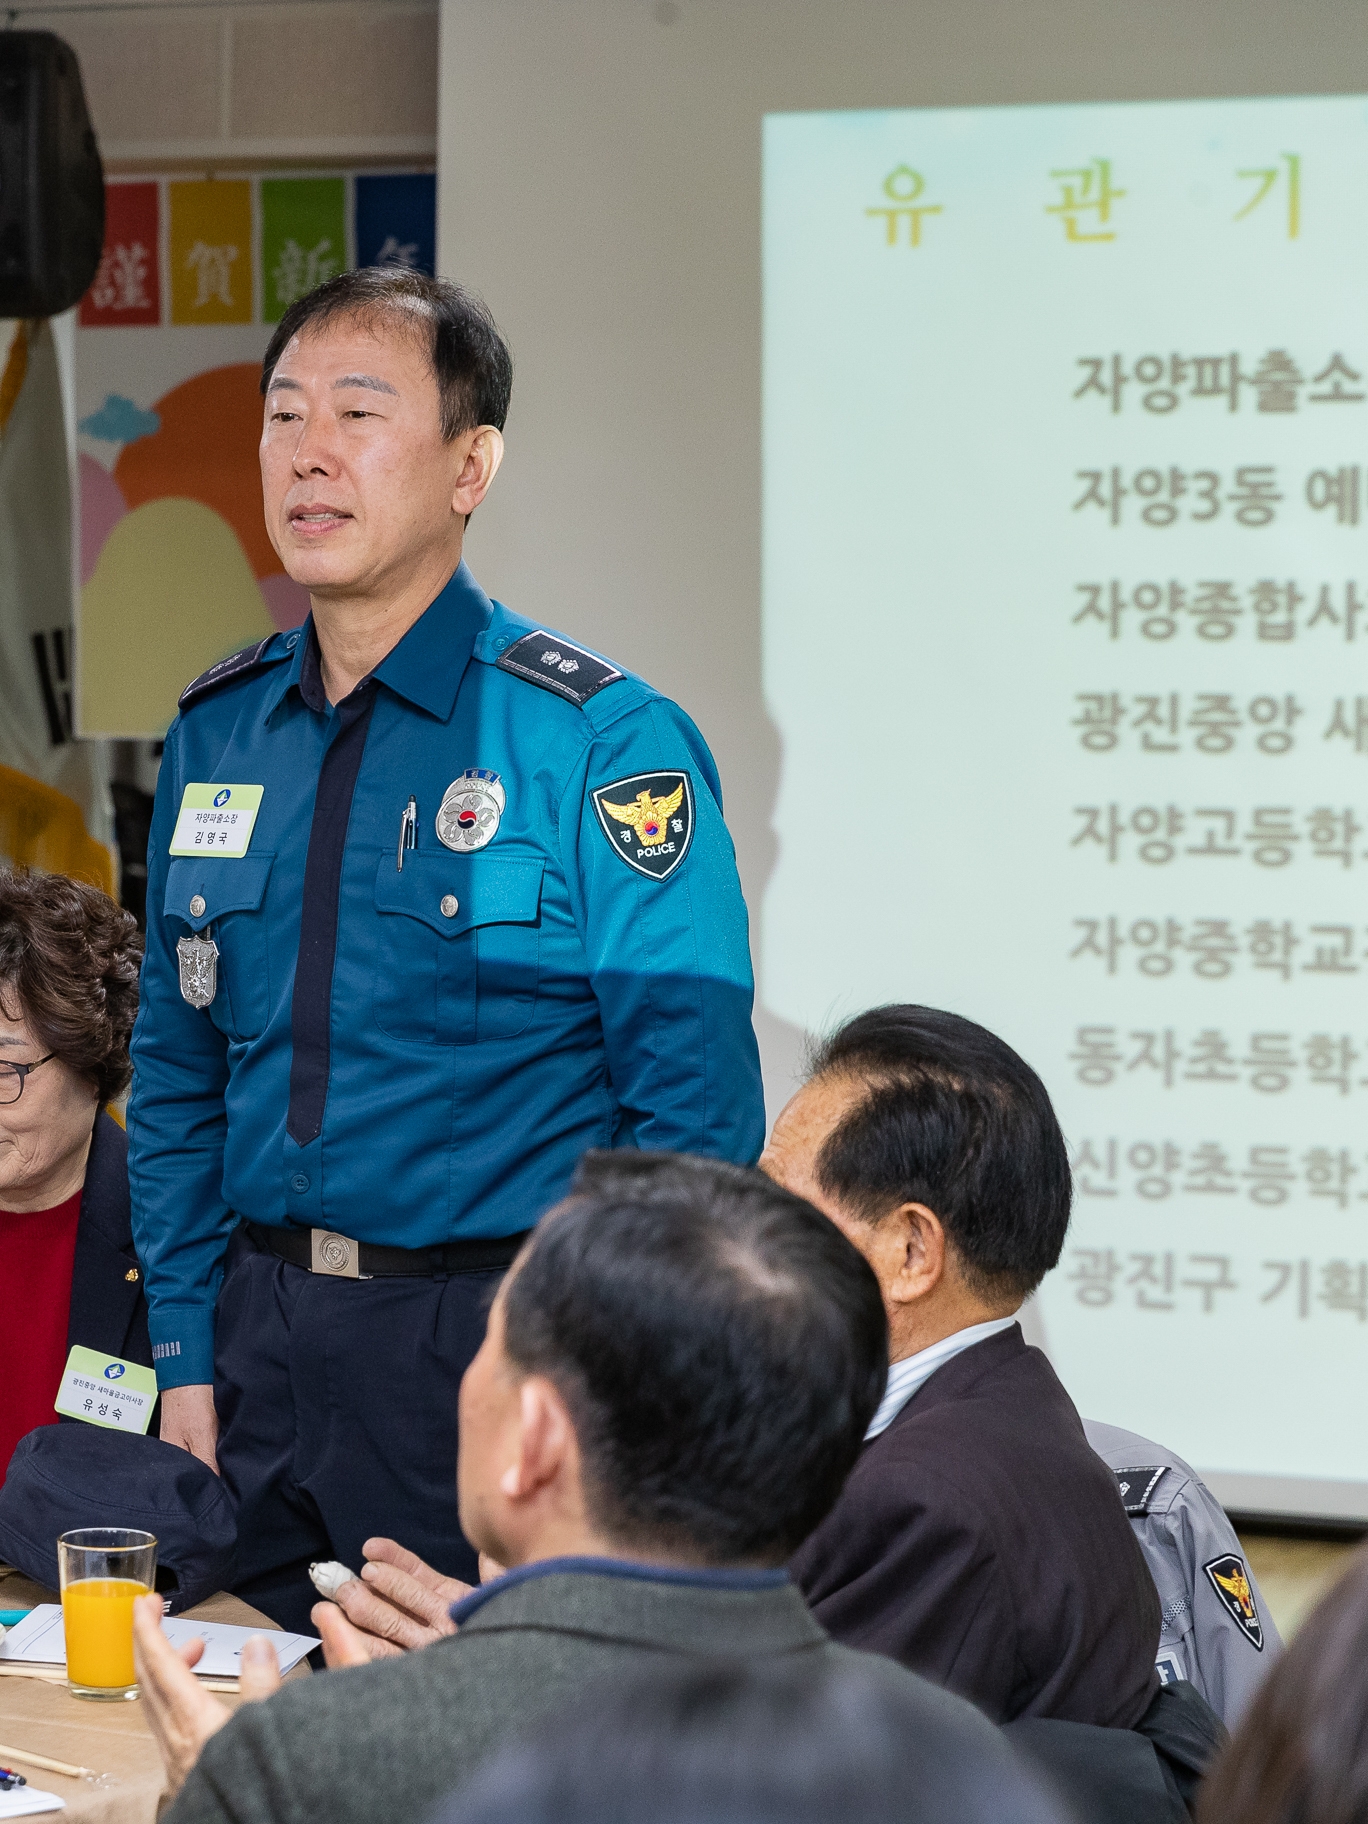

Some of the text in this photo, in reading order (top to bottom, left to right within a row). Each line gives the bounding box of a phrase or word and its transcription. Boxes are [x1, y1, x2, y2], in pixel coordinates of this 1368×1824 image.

[1073, 348, 1367, 414] 자양파출소
[1072, 464, 1368, 528] 자양3동 예
[1072, 577, 1368, 643] 자양종합사
[1070, 691, 1305, 755] 광진중앙
[194, 812, 239, 825] 자양파출소장
[636, 841, 676, 859] POLICE
[1069, 800, 1368, 869] 자양고등학
[1069, 914, 1368, 983] 자양중학교
[1066, 1023, 1368, 1097] 동자초등학
[1070, 1136, 1368, 1210] 신양초등학
[1065, 1248, 1239, 1315] 광진구
